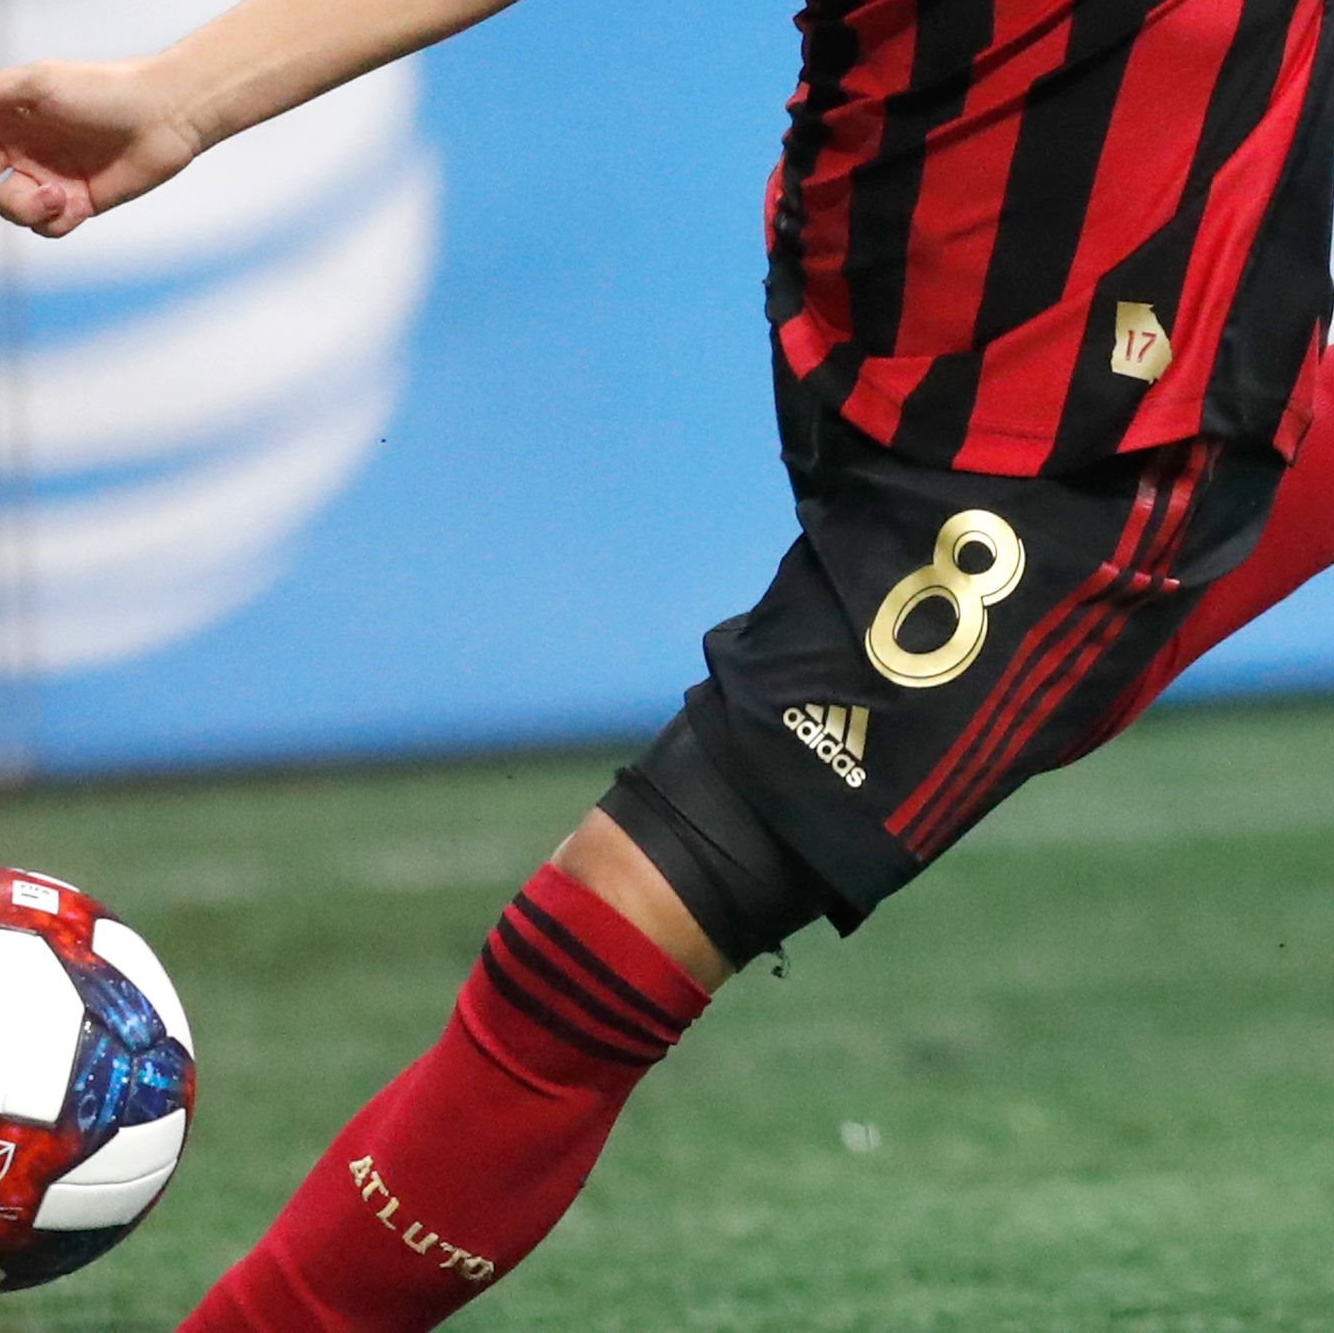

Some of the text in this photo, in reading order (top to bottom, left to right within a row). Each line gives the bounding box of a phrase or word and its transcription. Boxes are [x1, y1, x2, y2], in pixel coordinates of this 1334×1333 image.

[1126, 329, 1158, 363] 17
[865, 508, 1026, 688] 8
[782, 706, 867, 788] adidas
